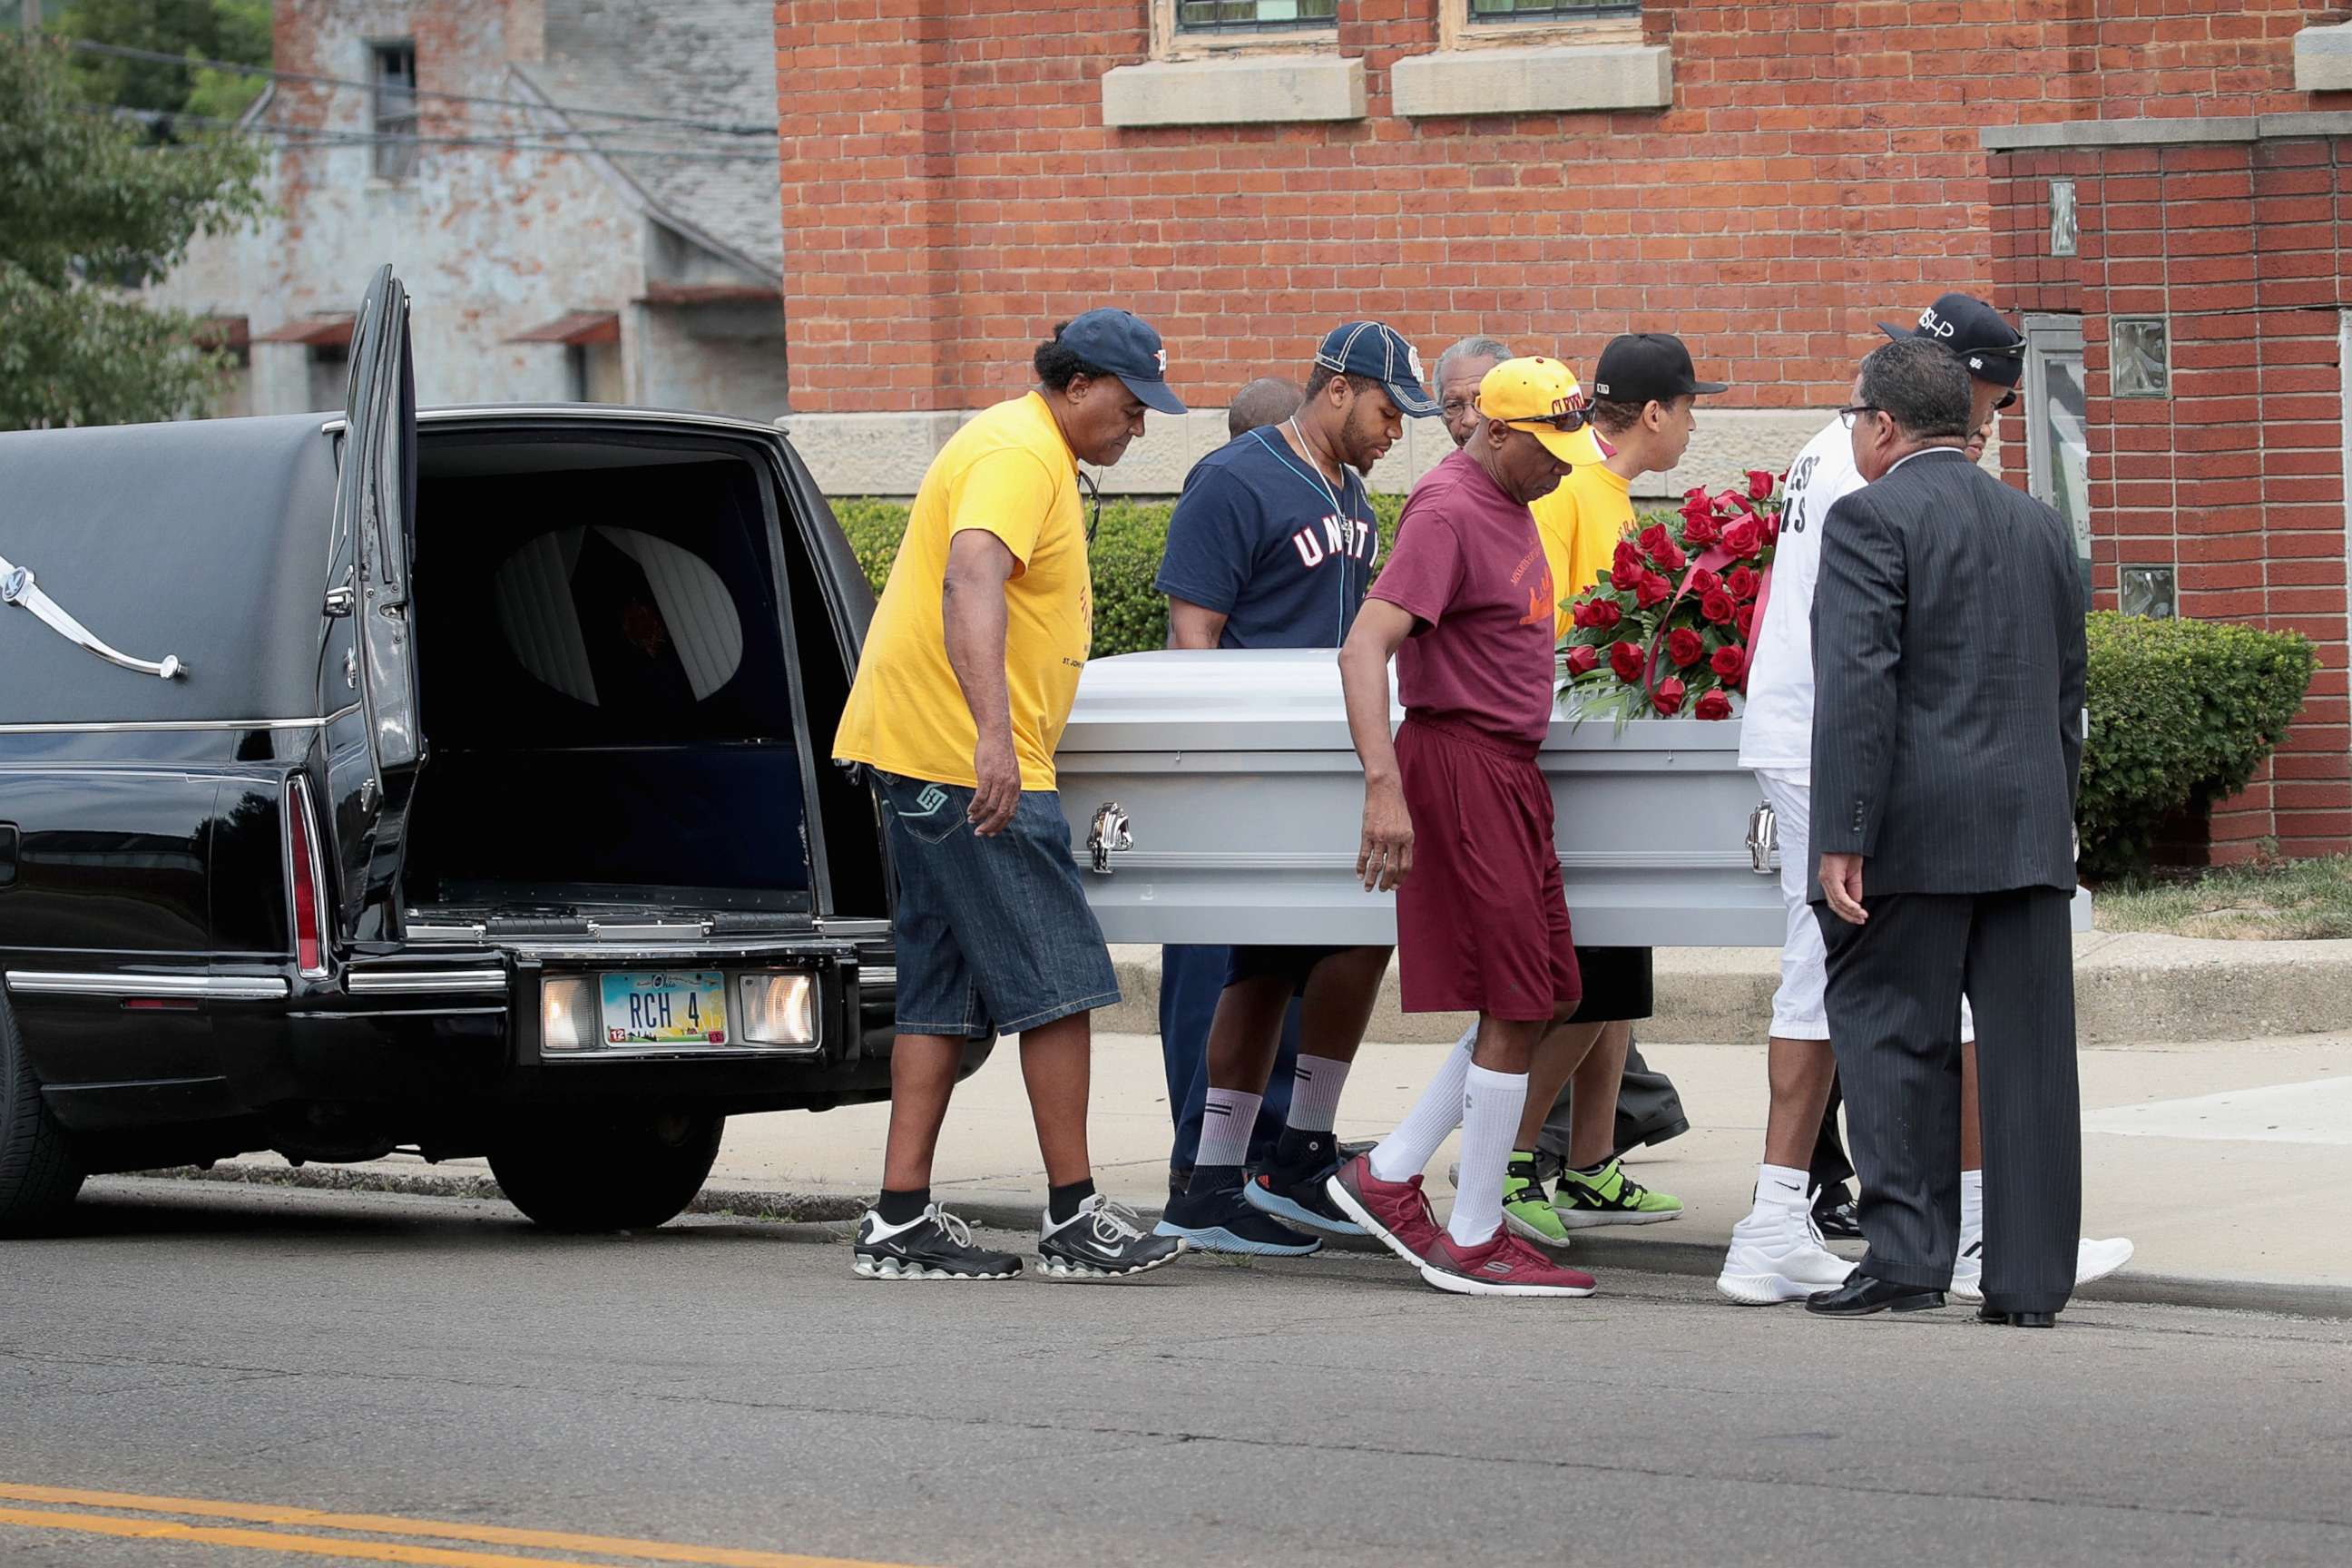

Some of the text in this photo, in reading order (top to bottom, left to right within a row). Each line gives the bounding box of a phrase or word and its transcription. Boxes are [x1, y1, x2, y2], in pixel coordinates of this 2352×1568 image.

[629, 992, 700, 1029] RCH 4
[610, 1030, 625, 1041] 12
